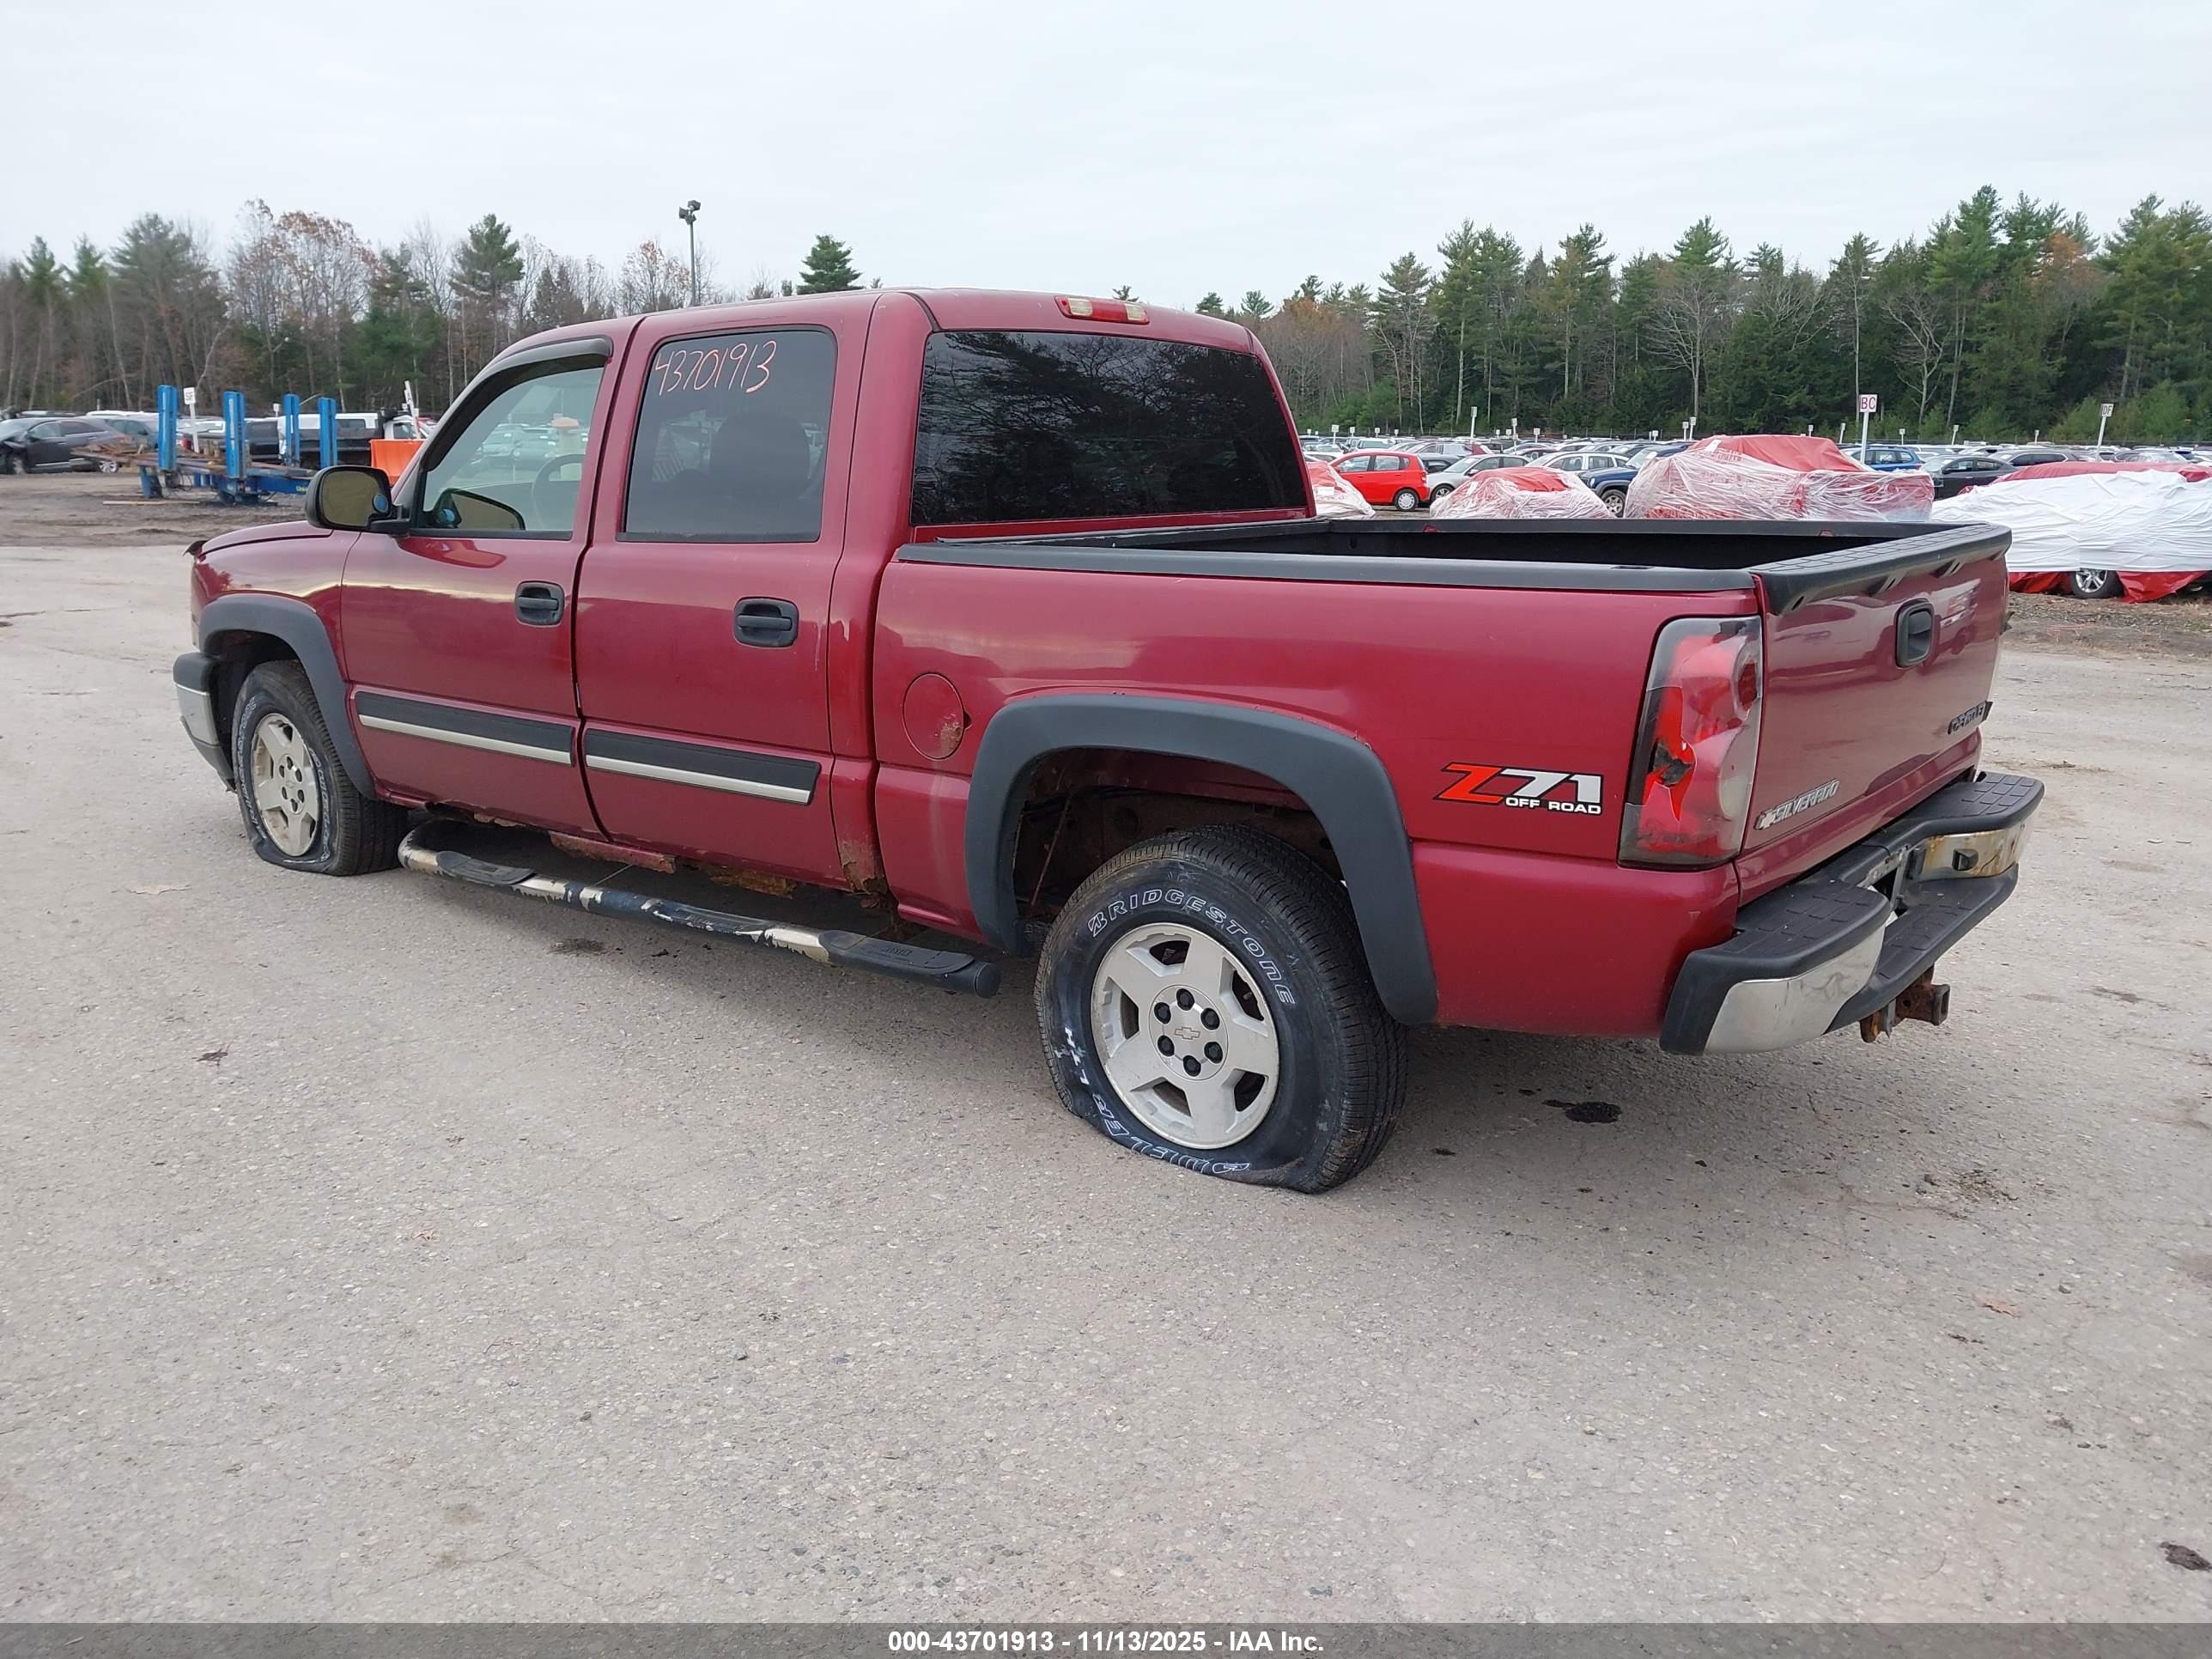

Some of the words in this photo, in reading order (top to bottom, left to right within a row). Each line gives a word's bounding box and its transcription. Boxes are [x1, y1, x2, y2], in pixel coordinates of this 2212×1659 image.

[654, 340, 777, 397] 43701913
[1861, 397, 1876, 410] BC
[1433, 762, 1604, 806] Z71
[1504, 796, 1540, 810] OFF
[1548, 799, 1602, 815] ROAD
[1772, 778, 1841, 824] SILVERADO
[1087, 889, 1297, 1006] BRIDGESTONE
